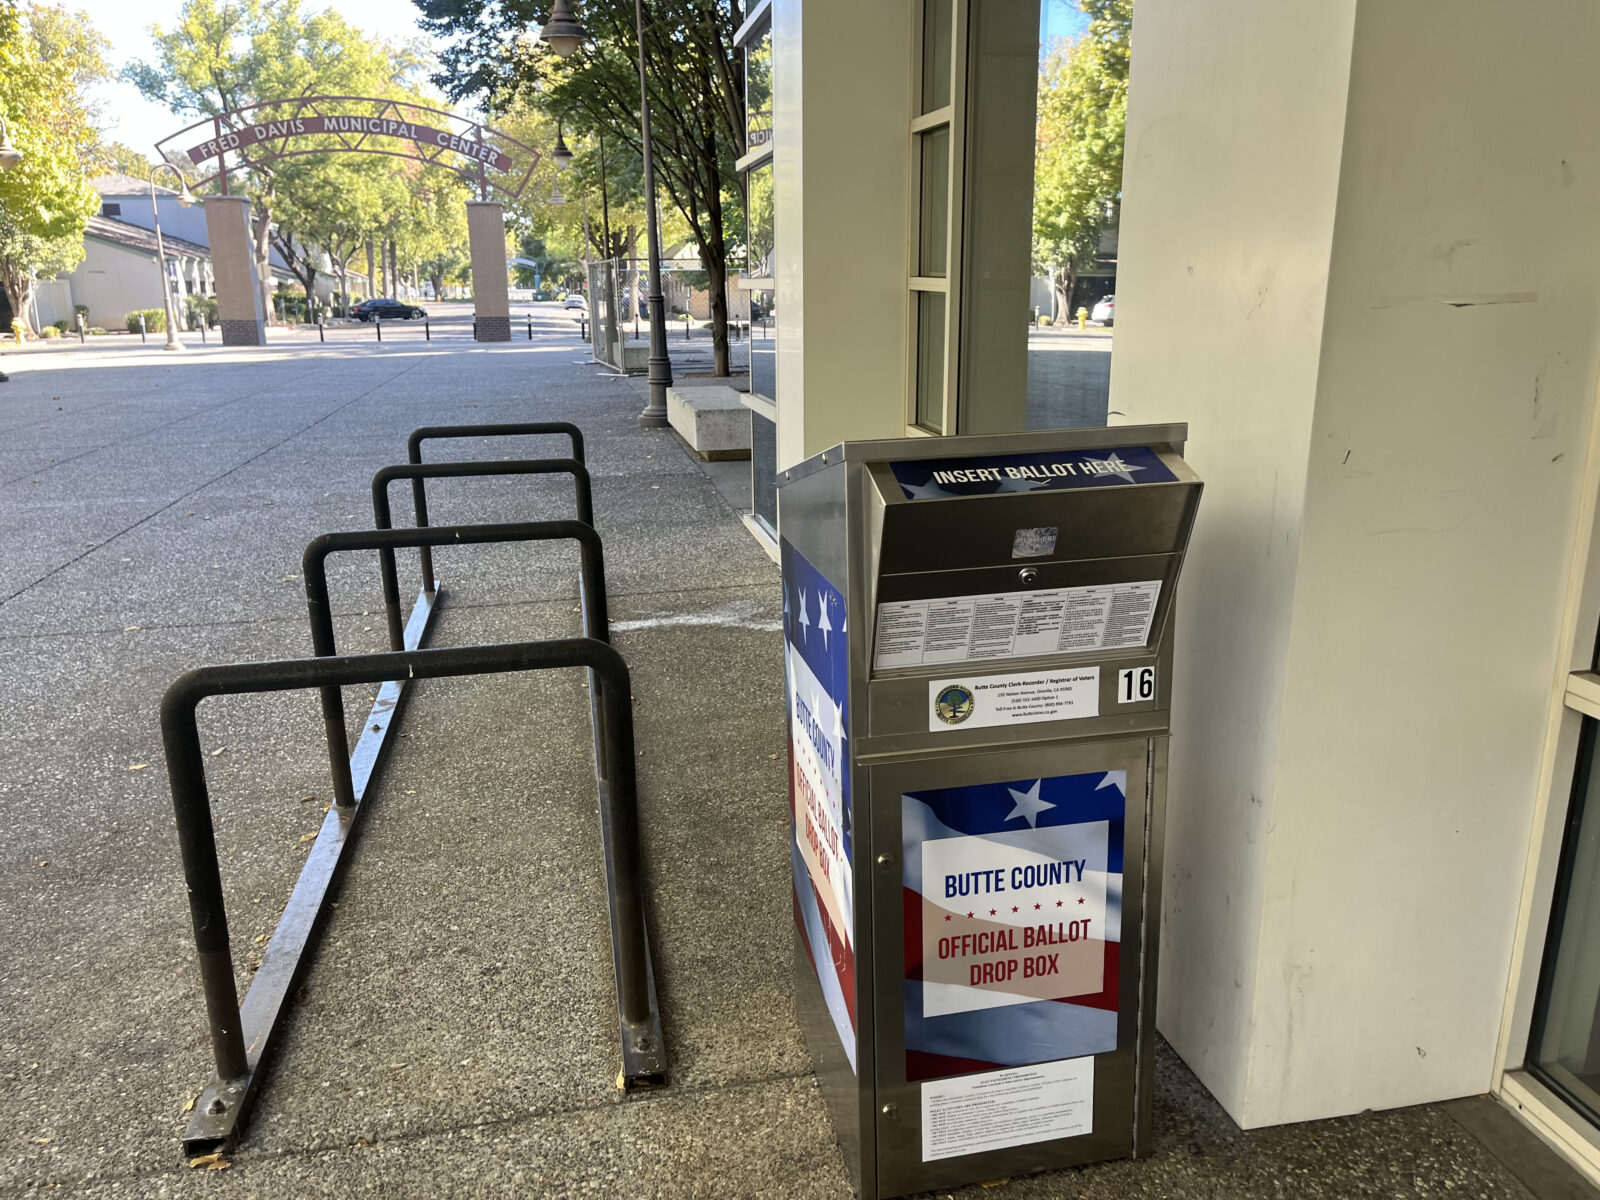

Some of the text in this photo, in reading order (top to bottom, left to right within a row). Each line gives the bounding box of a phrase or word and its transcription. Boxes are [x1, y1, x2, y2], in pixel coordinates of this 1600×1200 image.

[199, 117, 498, 165] FRED DAVIS MUNICIPAL CENTER
[933, 459, 1133, 485] INSERT BALLOT HERE
[1123, 668, 1153, 700] 16
[795, 691, 835, 778] BUTTE COUNTY
[818, 800, 839, 862] BALLOT
[945, 859, 1087, 899] BUTTE COUNTY
[938, 918, 1092, 960] OFFICIAL BALLOT
[970, 953, 1060, 986] DROP BOX
